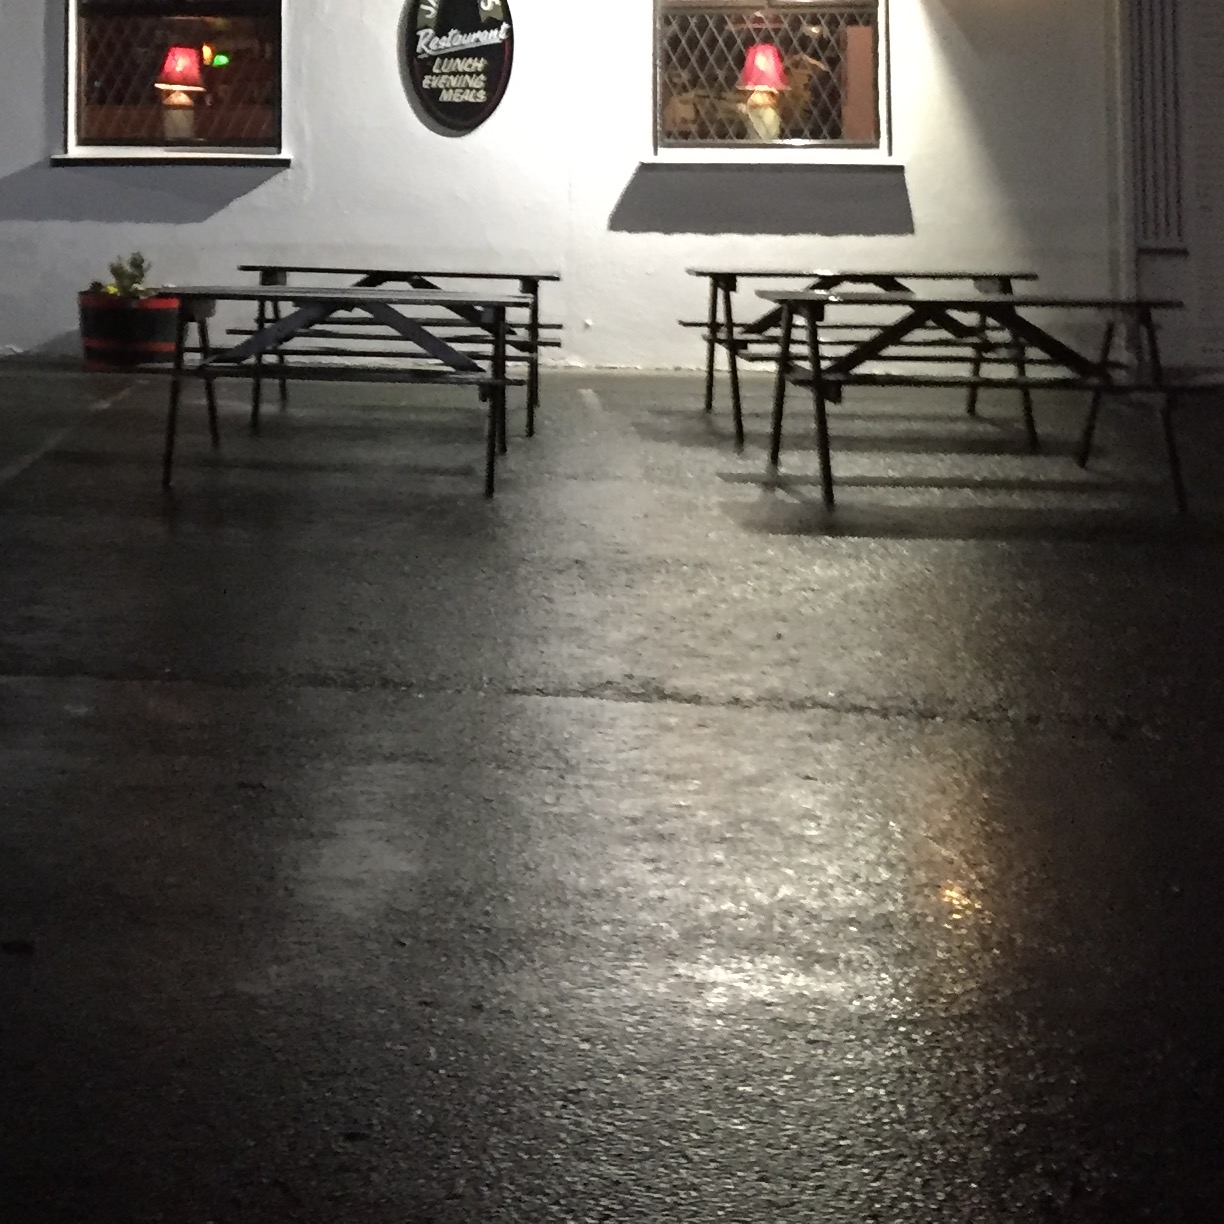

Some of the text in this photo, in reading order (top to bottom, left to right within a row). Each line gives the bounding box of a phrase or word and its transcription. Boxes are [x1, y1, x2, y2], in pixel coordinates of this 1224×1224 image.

[416, 21, 510, 56] Restaurant
[432, 57, 487, 73] LUNCH
[422, 74, 487, 89] EVENING
[439, 89, 487, 102] MEALS
